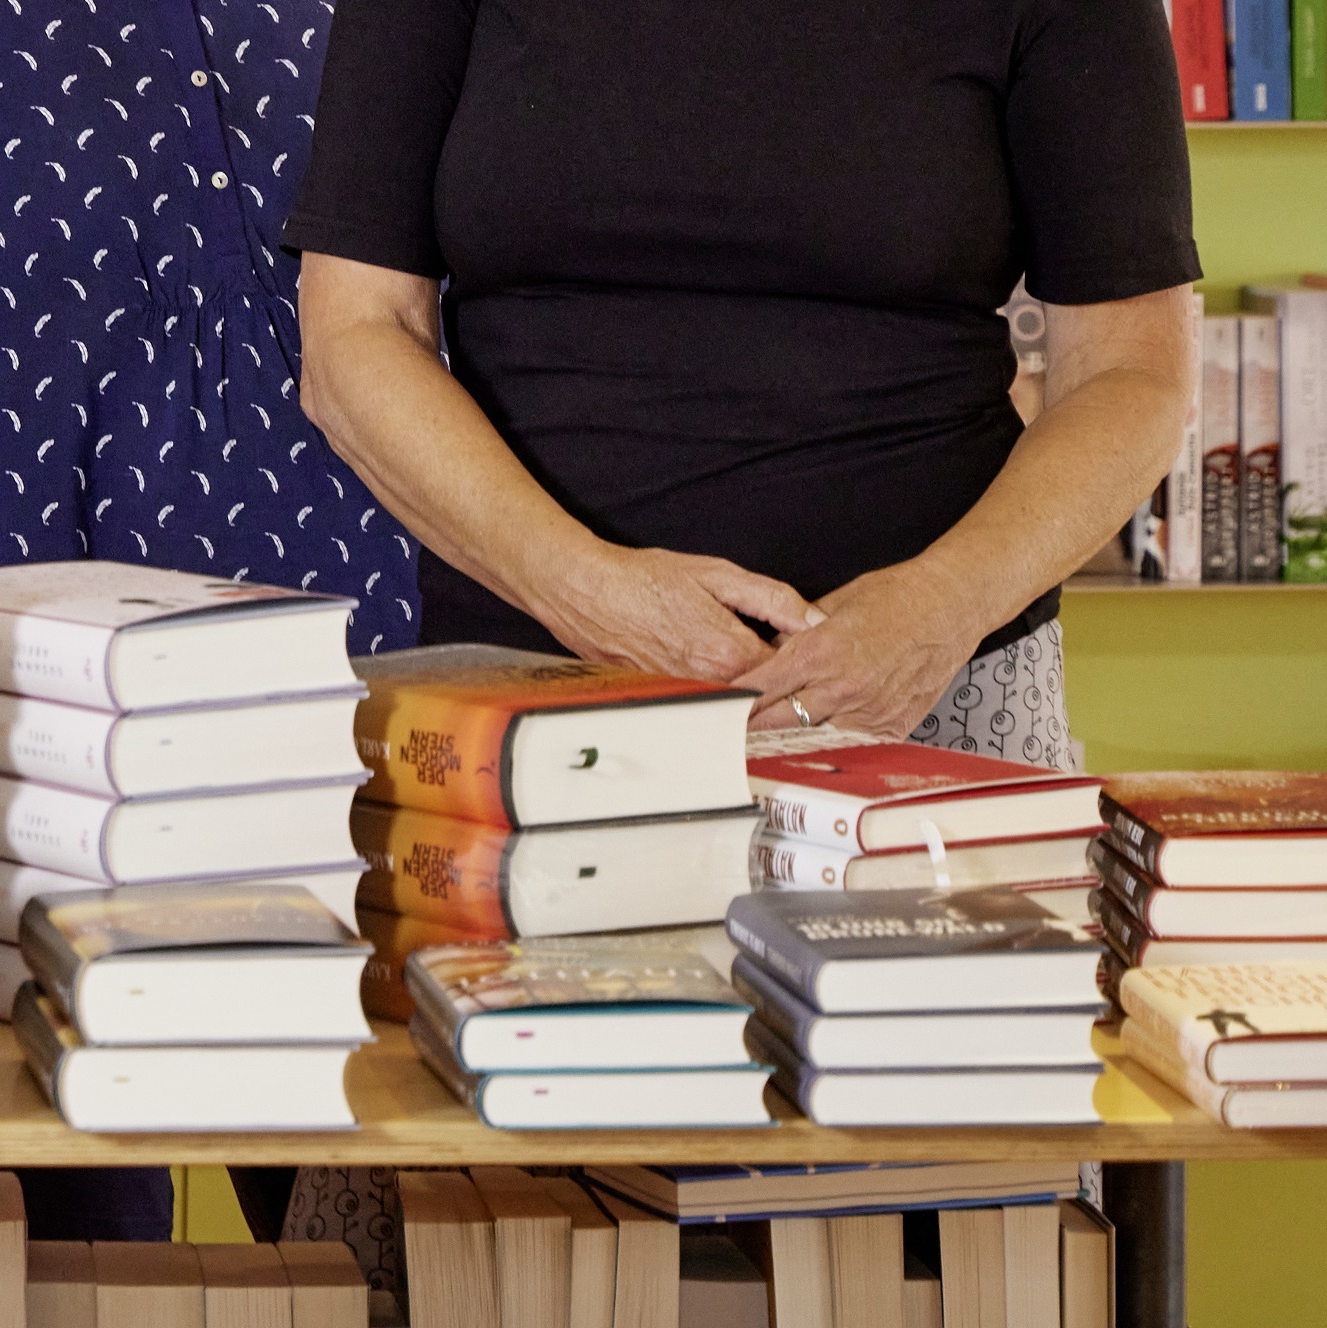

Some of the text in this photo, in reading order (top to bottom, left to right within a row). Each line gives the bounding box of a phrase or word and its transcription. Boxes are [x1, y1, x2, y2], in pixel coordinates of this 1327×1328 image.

[409, 728, 456, 753] STERN
[399, 744, 462, 773] MORGEN
[416, 766, 446, 787] DER
